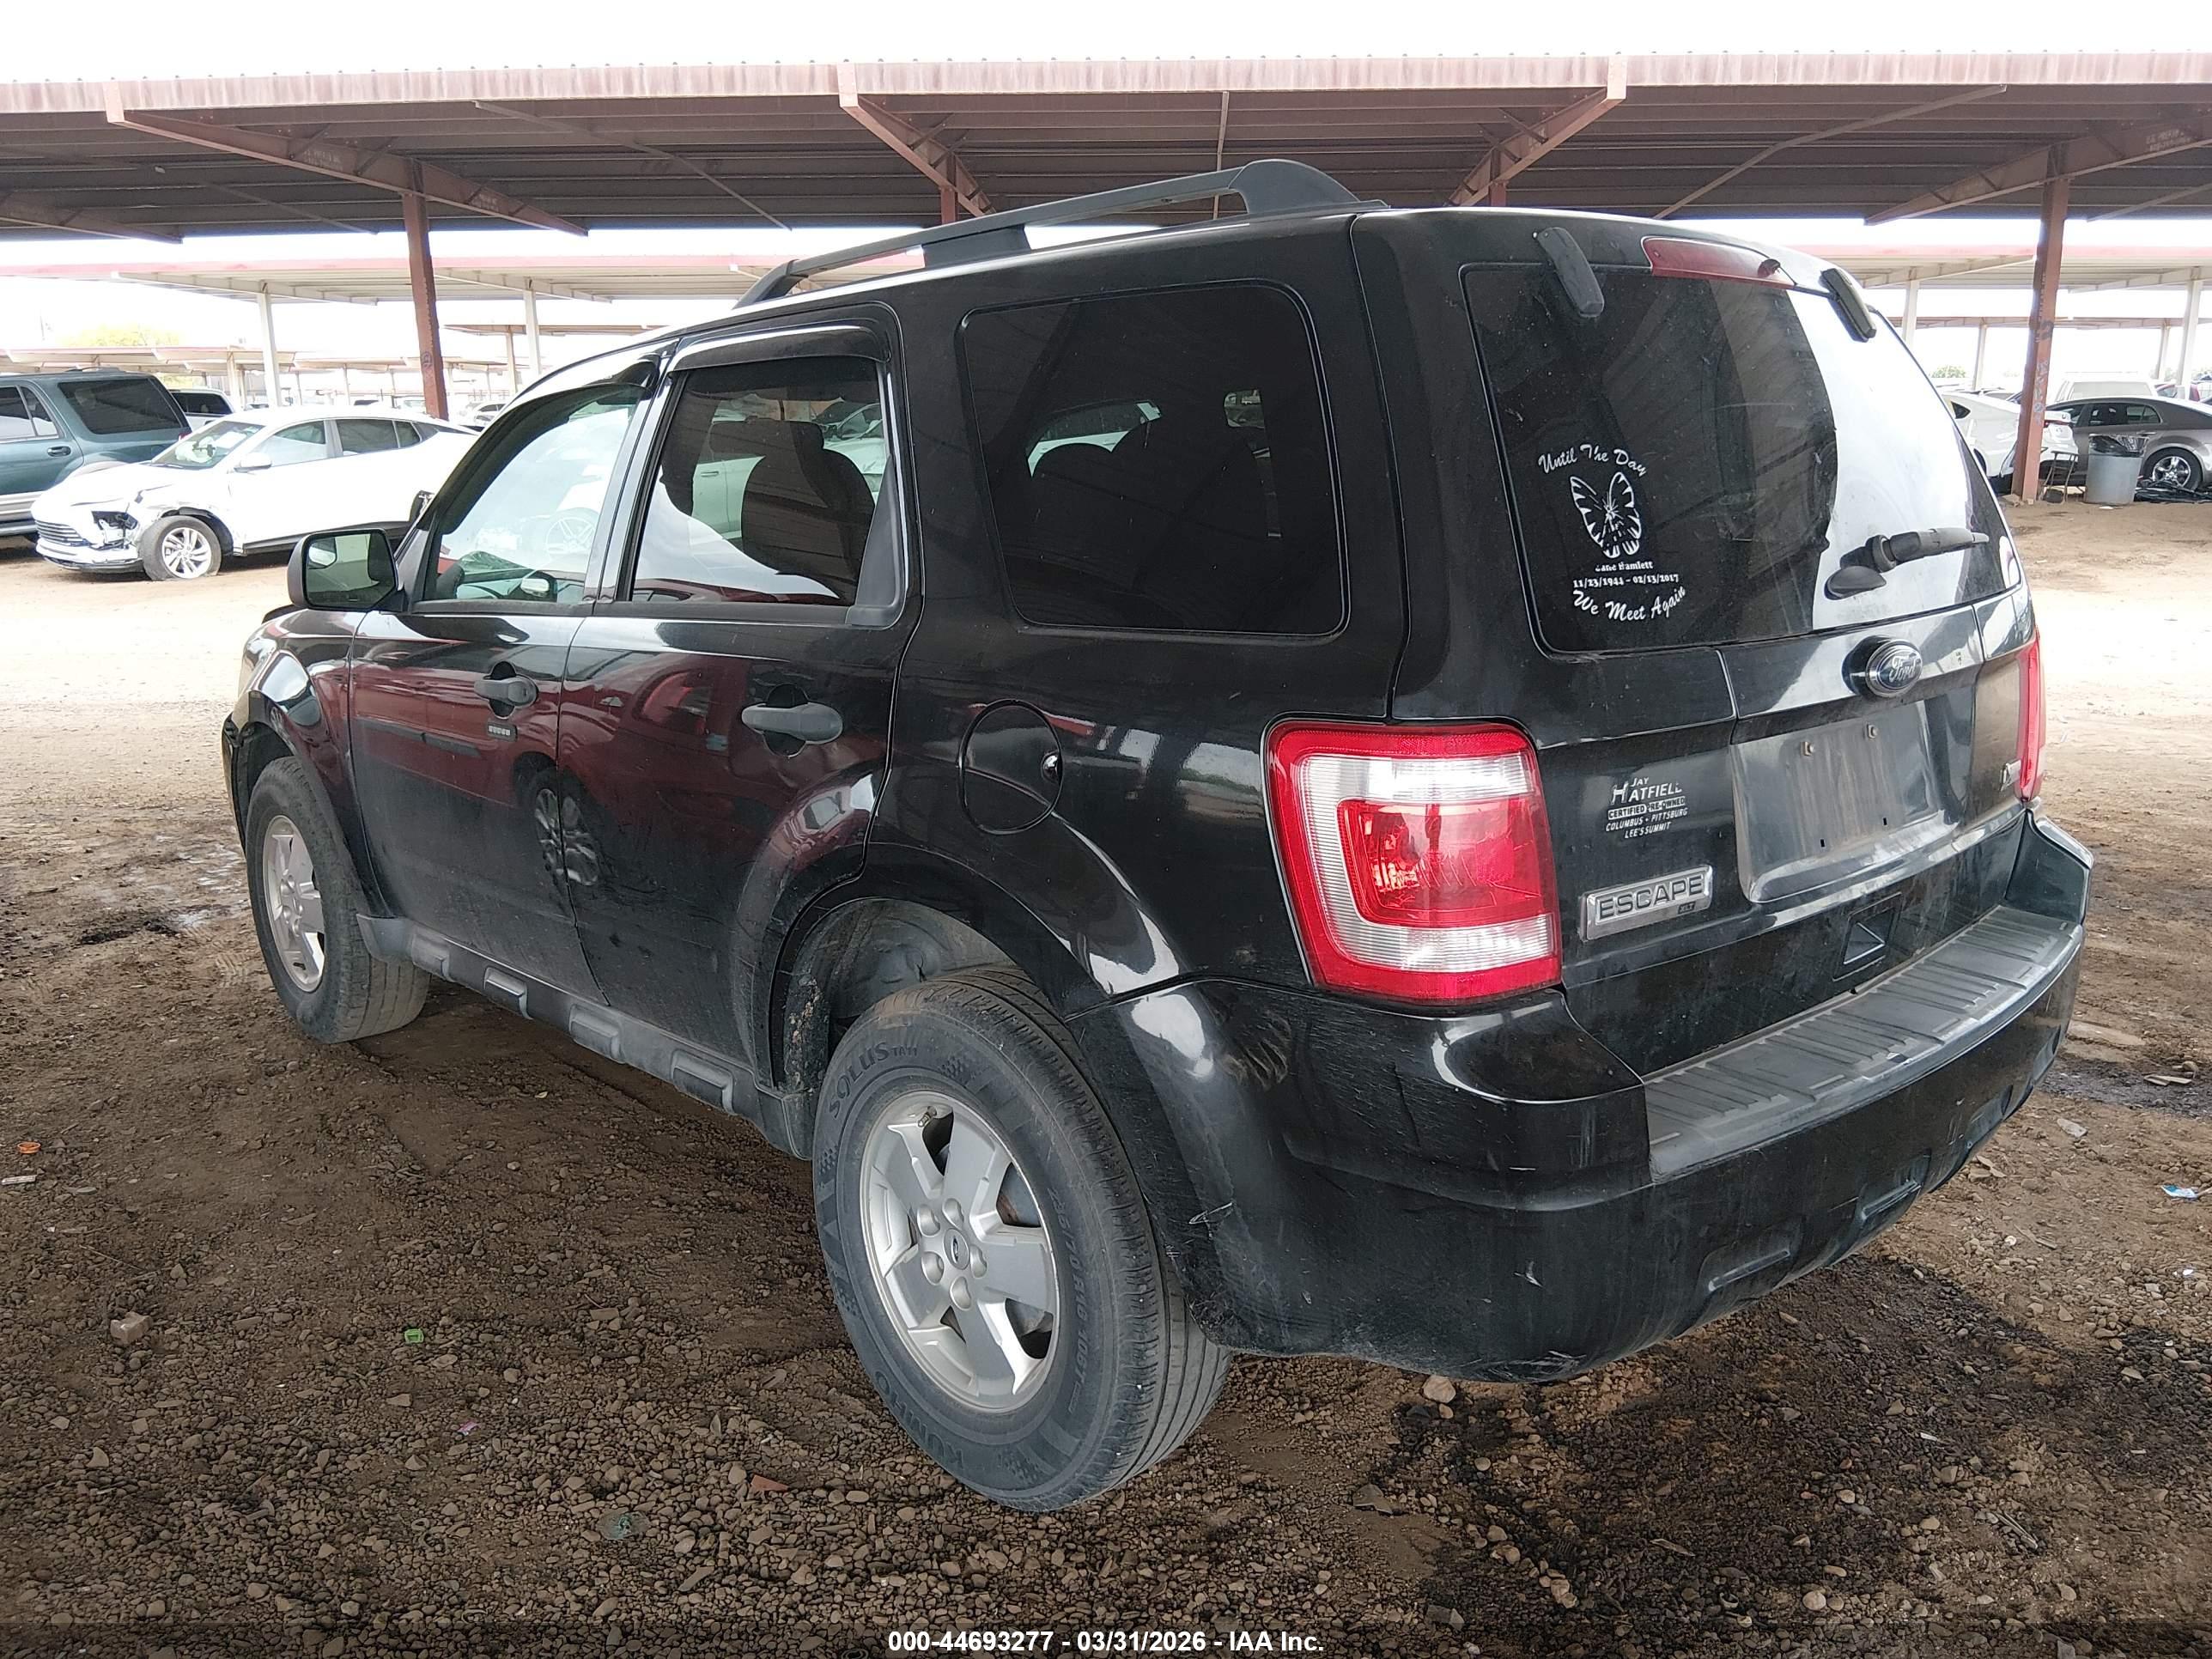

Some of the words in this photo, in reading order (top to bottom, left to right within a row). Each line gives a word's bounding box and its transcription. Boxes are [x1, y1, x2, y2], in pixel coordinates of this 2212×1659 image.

[1538, 447, 1577, 473] Until
[1580, 444, 1609, 462] The
[1613, 448, 1647, 477] Day
[1632, 574, 1680, 586] 02/13/2017
[1572, 589, 1600, 615] We
[1605, 601, 1647, 621] Meet
[1651, 585, 1686, 618] Again
[1888, 654, 1917, 683] Ford
[1630, 776, 1650, 787] JAY
[1605, 816, 1644, 832] COLUMBUS
[1650, 807, 1689, 823] PITTSBURG
[1608, 805, 1646, 819] CERTIFIED
[1648, 796, 1686, 812] RE-OWNED
[1644, 821, 1672, 835] SUMMIT
[1599, 873, 1705, 921] ESCAPE
[829, 1041, 890, 1120] SOLUS
[872, 1370, 964, 1470] KUMHO
